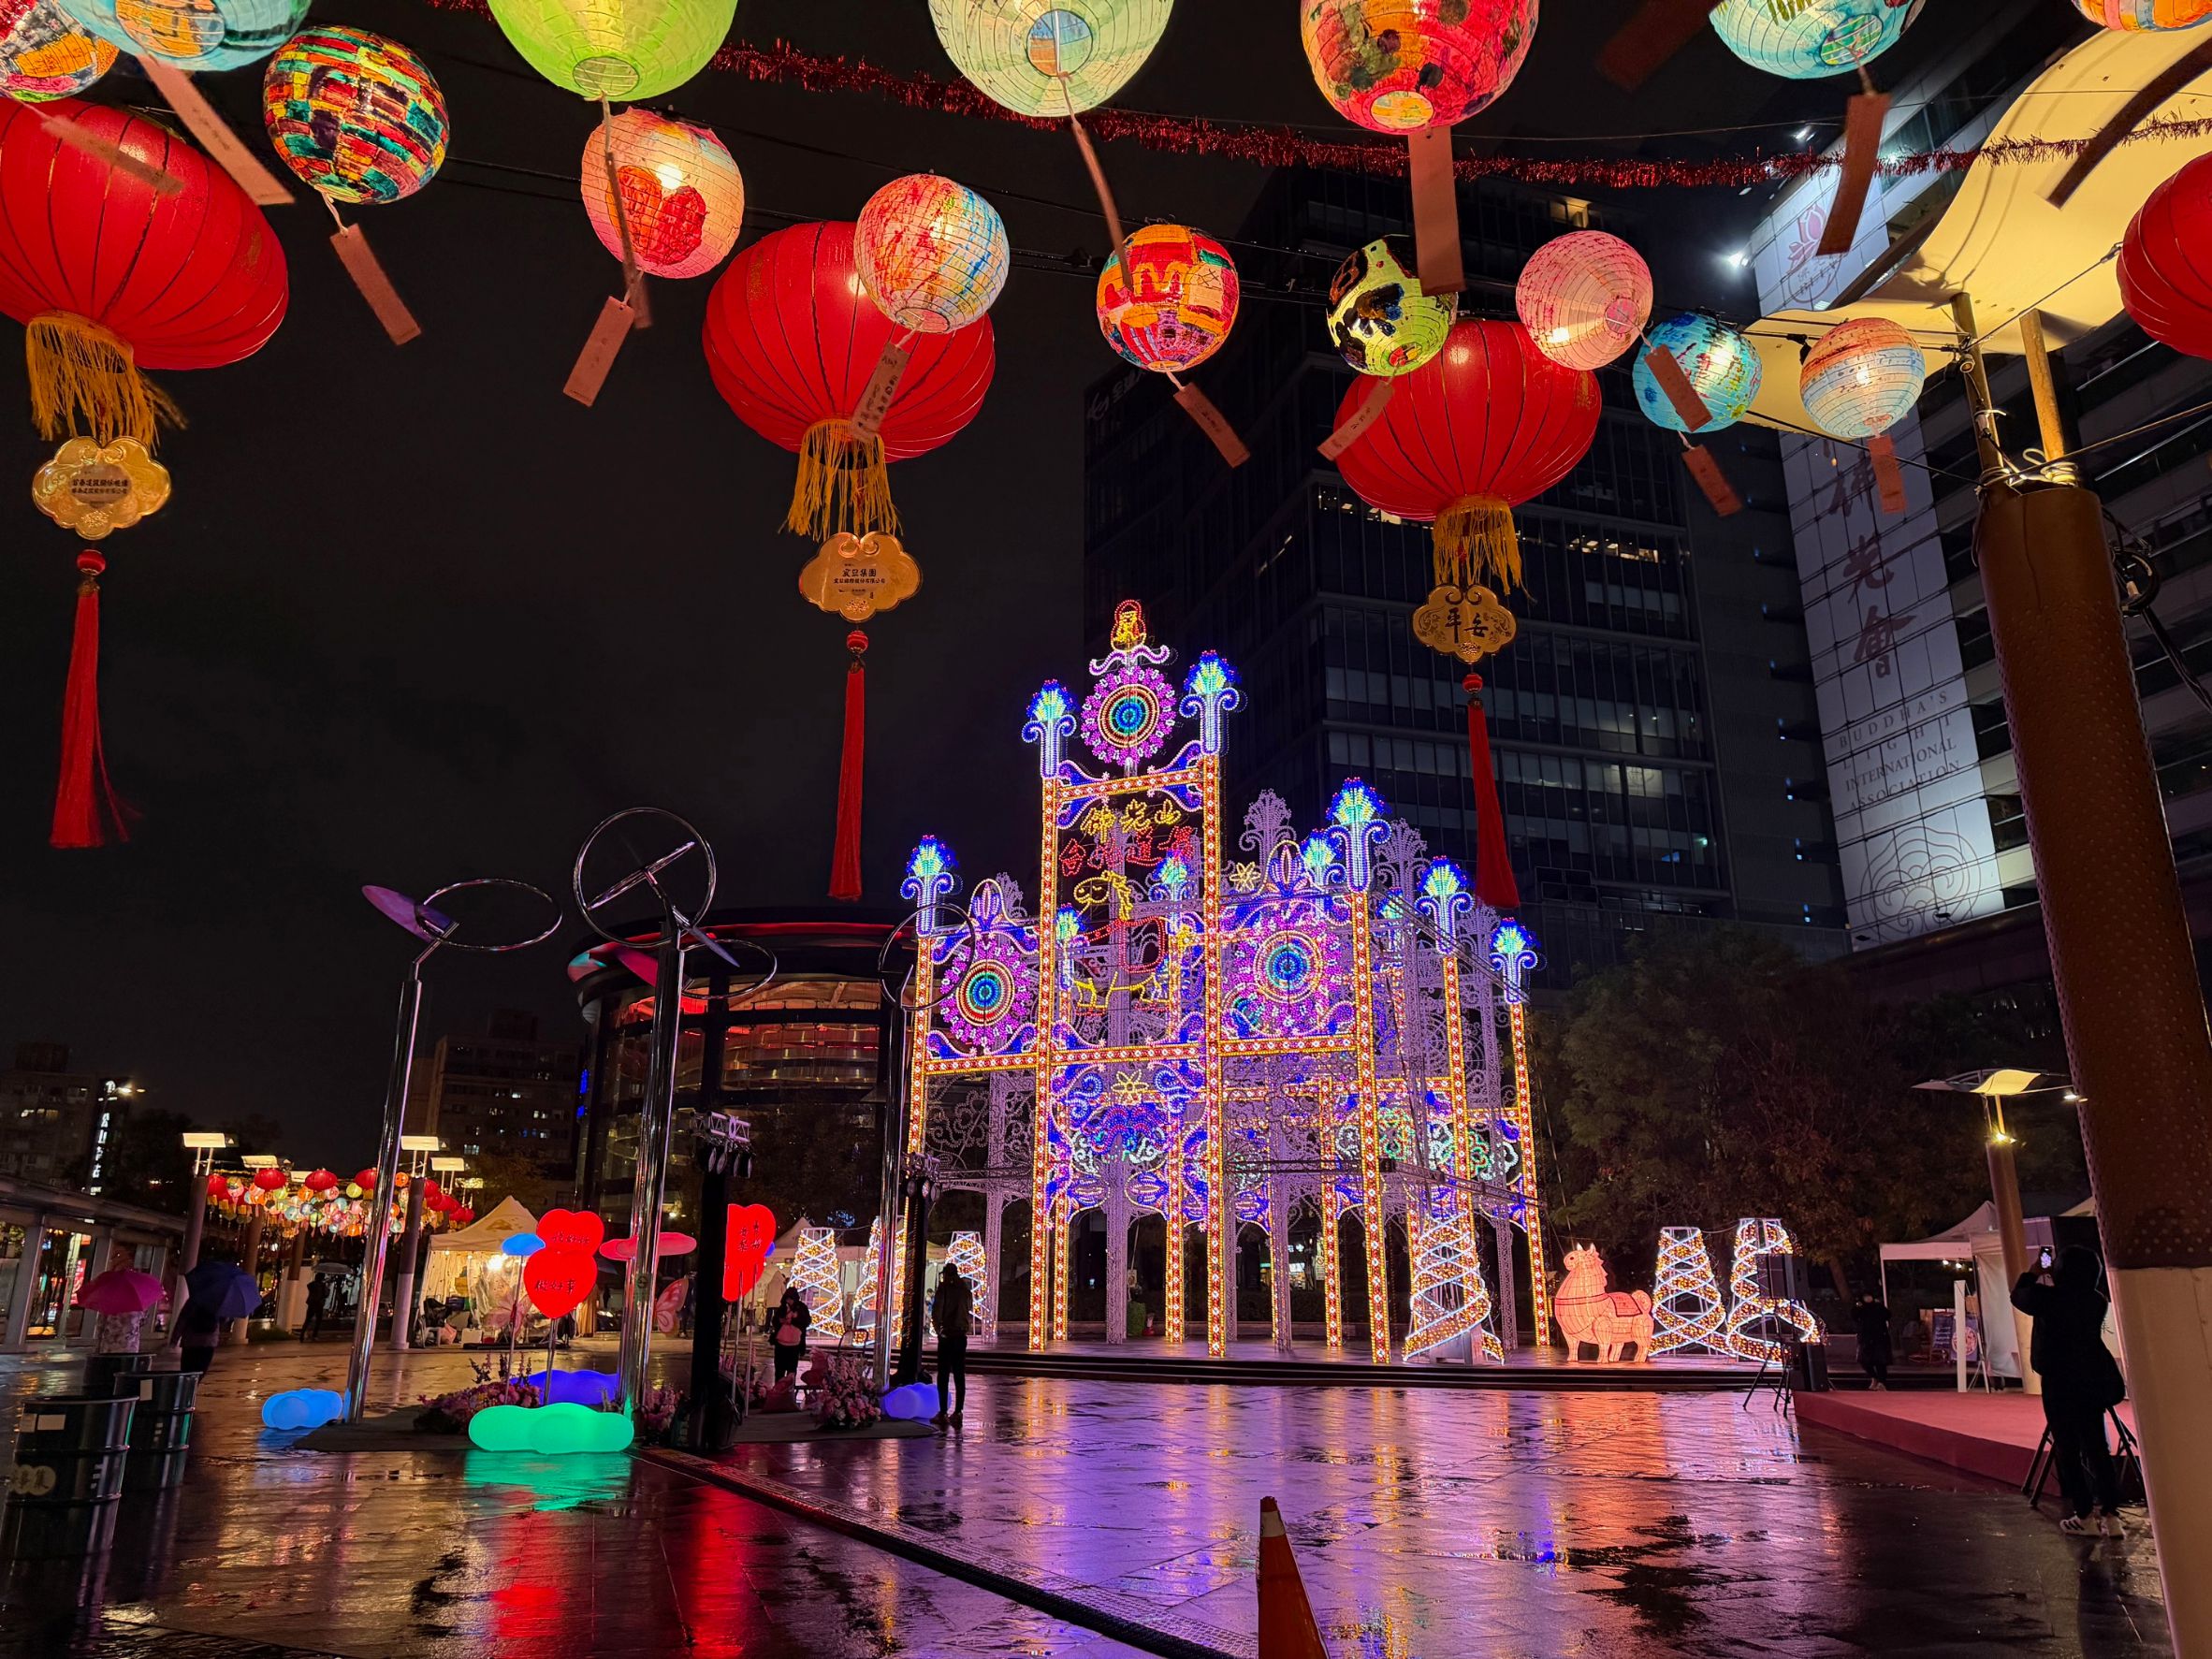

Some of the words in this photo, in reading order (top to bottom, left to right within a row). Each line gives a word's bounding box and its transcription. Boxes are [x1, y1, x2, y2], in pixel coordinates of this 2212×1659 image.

[1839, 690, 1948, 749] BUDDHA'S
[1844, 737, 1957, 793] INTERNATIONAL
[1850, 759, 1961, 810] ASSOCIATION
[1080, 798, 1182, 843] 佛光山
